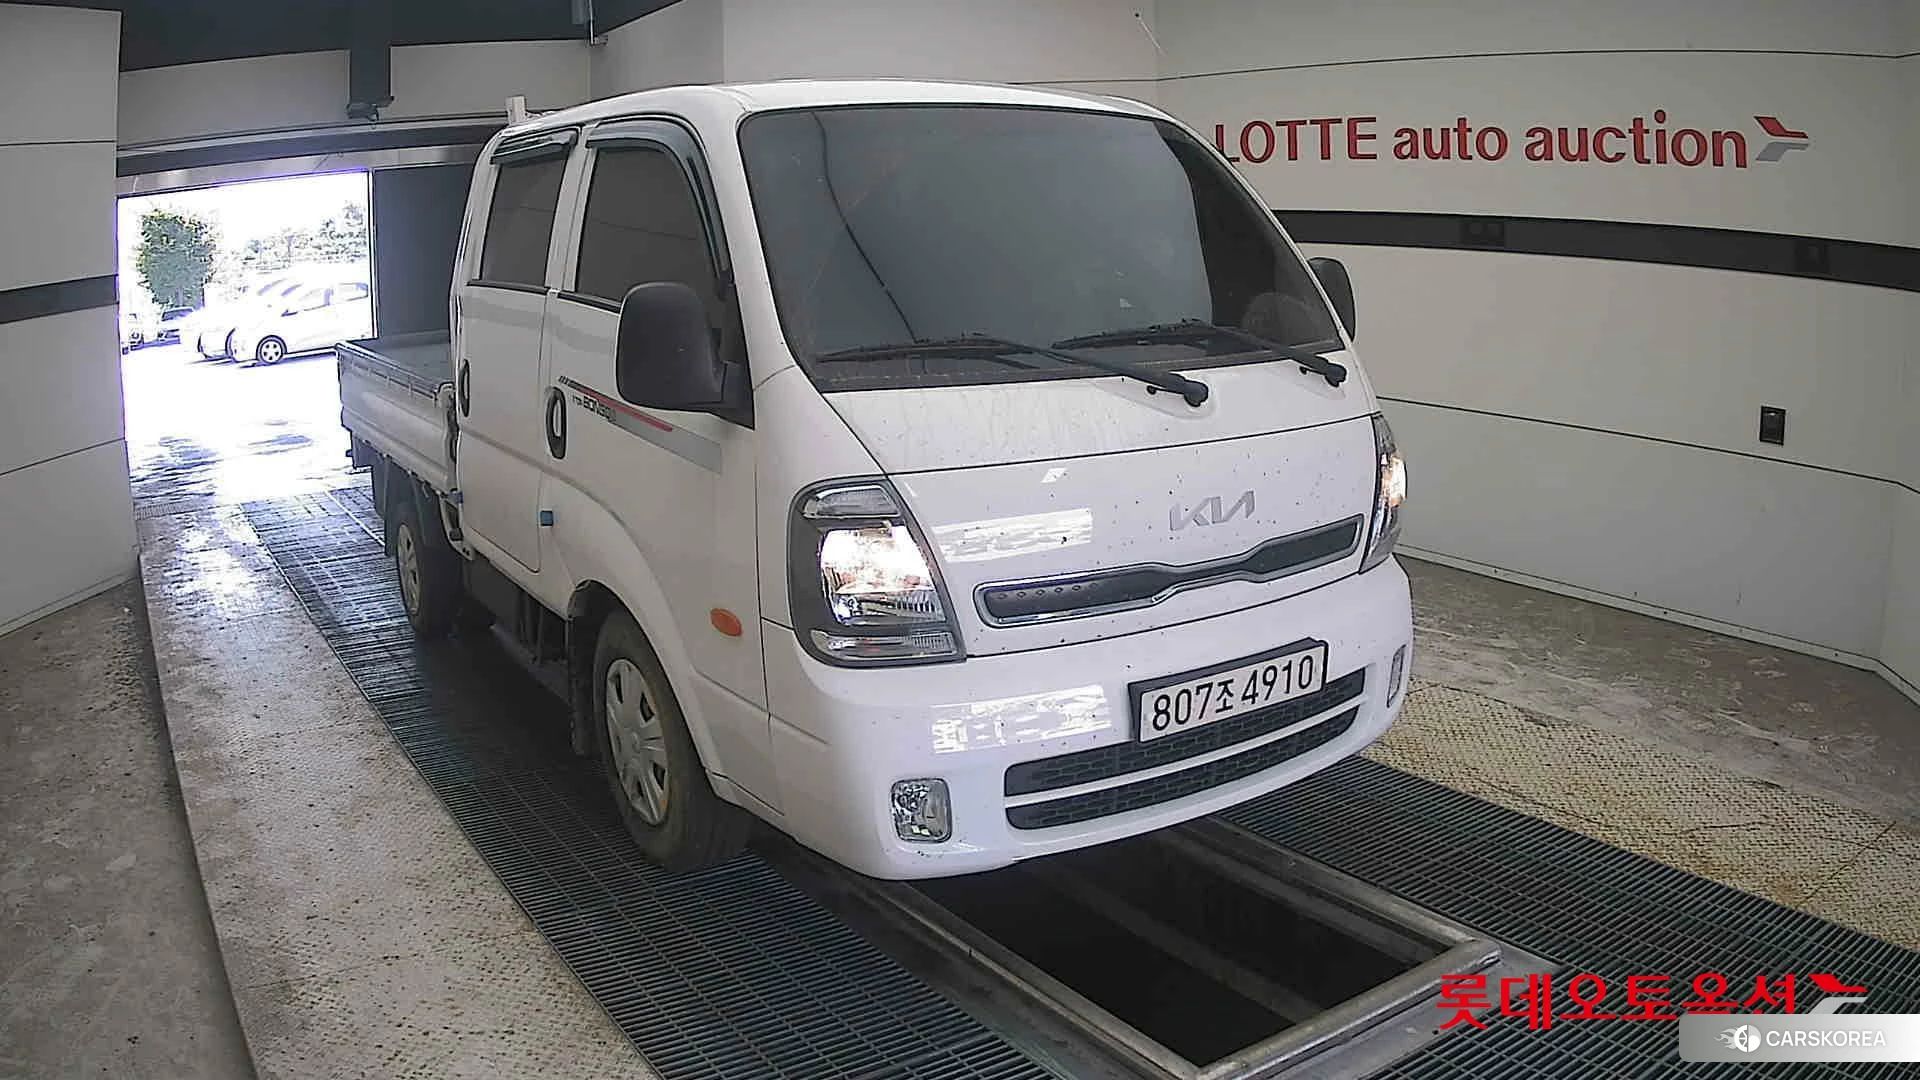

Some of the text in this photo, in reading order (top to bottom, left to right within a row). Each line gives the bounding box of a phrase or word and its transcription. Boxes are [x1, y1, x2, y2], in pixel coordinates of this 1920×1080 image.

[1215, 110, 1748, 169] LOTTE auto auction
